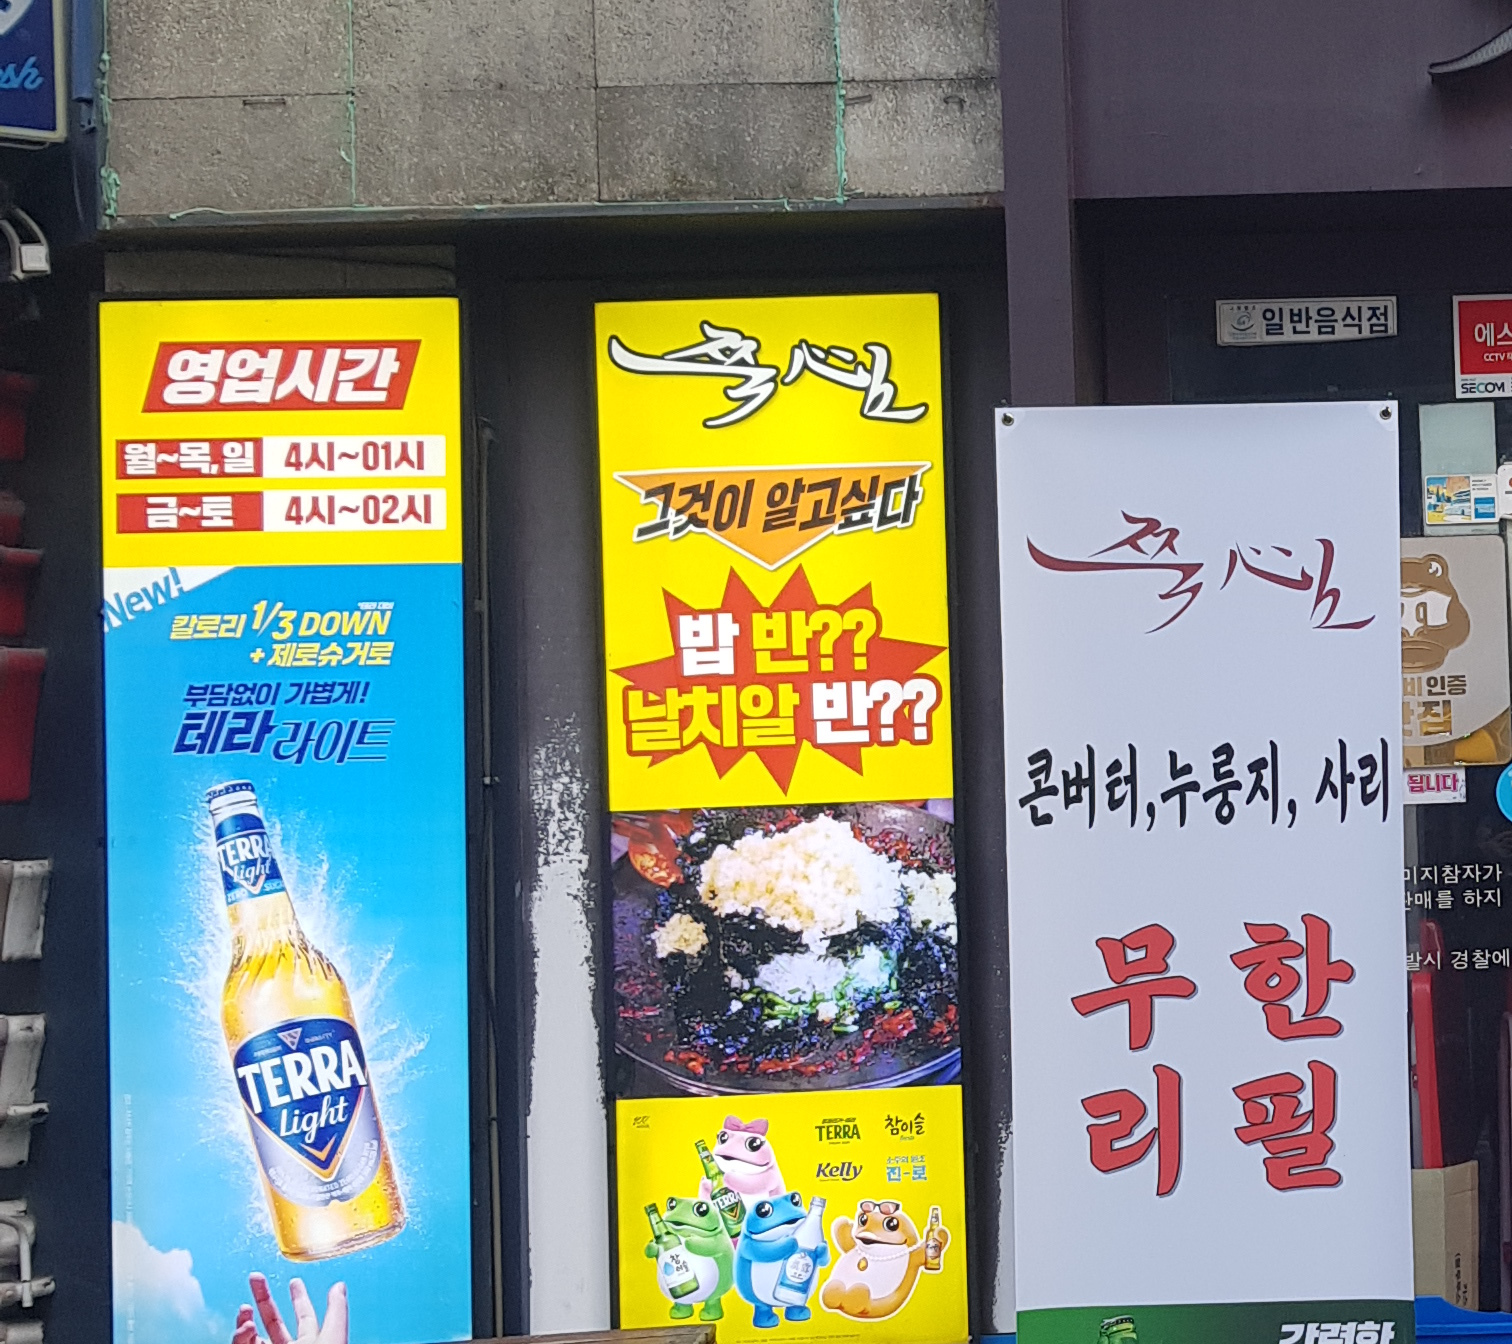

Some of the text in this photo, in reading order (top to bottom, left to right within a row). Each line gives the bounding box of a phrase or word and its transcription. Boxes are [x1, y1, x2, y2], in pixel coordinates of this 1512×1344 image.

[1262, 305, 1388, 336] 일반음식점
[1484, 353, 1506, 362] CCTV
[162, 347, 400, 405] 영업시간
[1461, 382, 1505, 394] SECOM
[123, 440, 425, 475] 월~목,일 4시~01시
[145, 494, 432, 530] 금~토 4시~02시
[635, 475, 923, 538] 그것이 알고싶다
[100, 567, 185, 632] New!
[169, 612, 247, 640] 칼로리
[299, 610, 392, 637] DOWN
[267, 641, 395, 667] 제로슈거로
[678, 609, 878, 677] 밥 반??
[183, 680, 371, 707] 부담없이 가볍게!
[1426, 675, 1467, 696] 인증
[627, 679, 938, 751] 날치알 반??
[172, 709, 396, 765] 테라 라이트
[1315, 737, 1389, 826] 사리
[1408, 773, 1458, 793] 됩니다
[218, 834, 273, 871] TERRA
[233, 856, 272, 886] Light
[1404, 863, 1503, 885] 미지참자가
[1463, 887, 1501, 908] 하지
[1450, 948, 1510, 969] 경찰에
[237, 1039, 368, 1115] TERRA
[280, 1095, 349, 1143] Light
[815, 1124, 861, 1142] TERRA
[885, 1112, 925, 1135] 참이슬
[1081, 1060, 1342, 1196] 리필
[816, 1161, 863, 1181] Kelly
